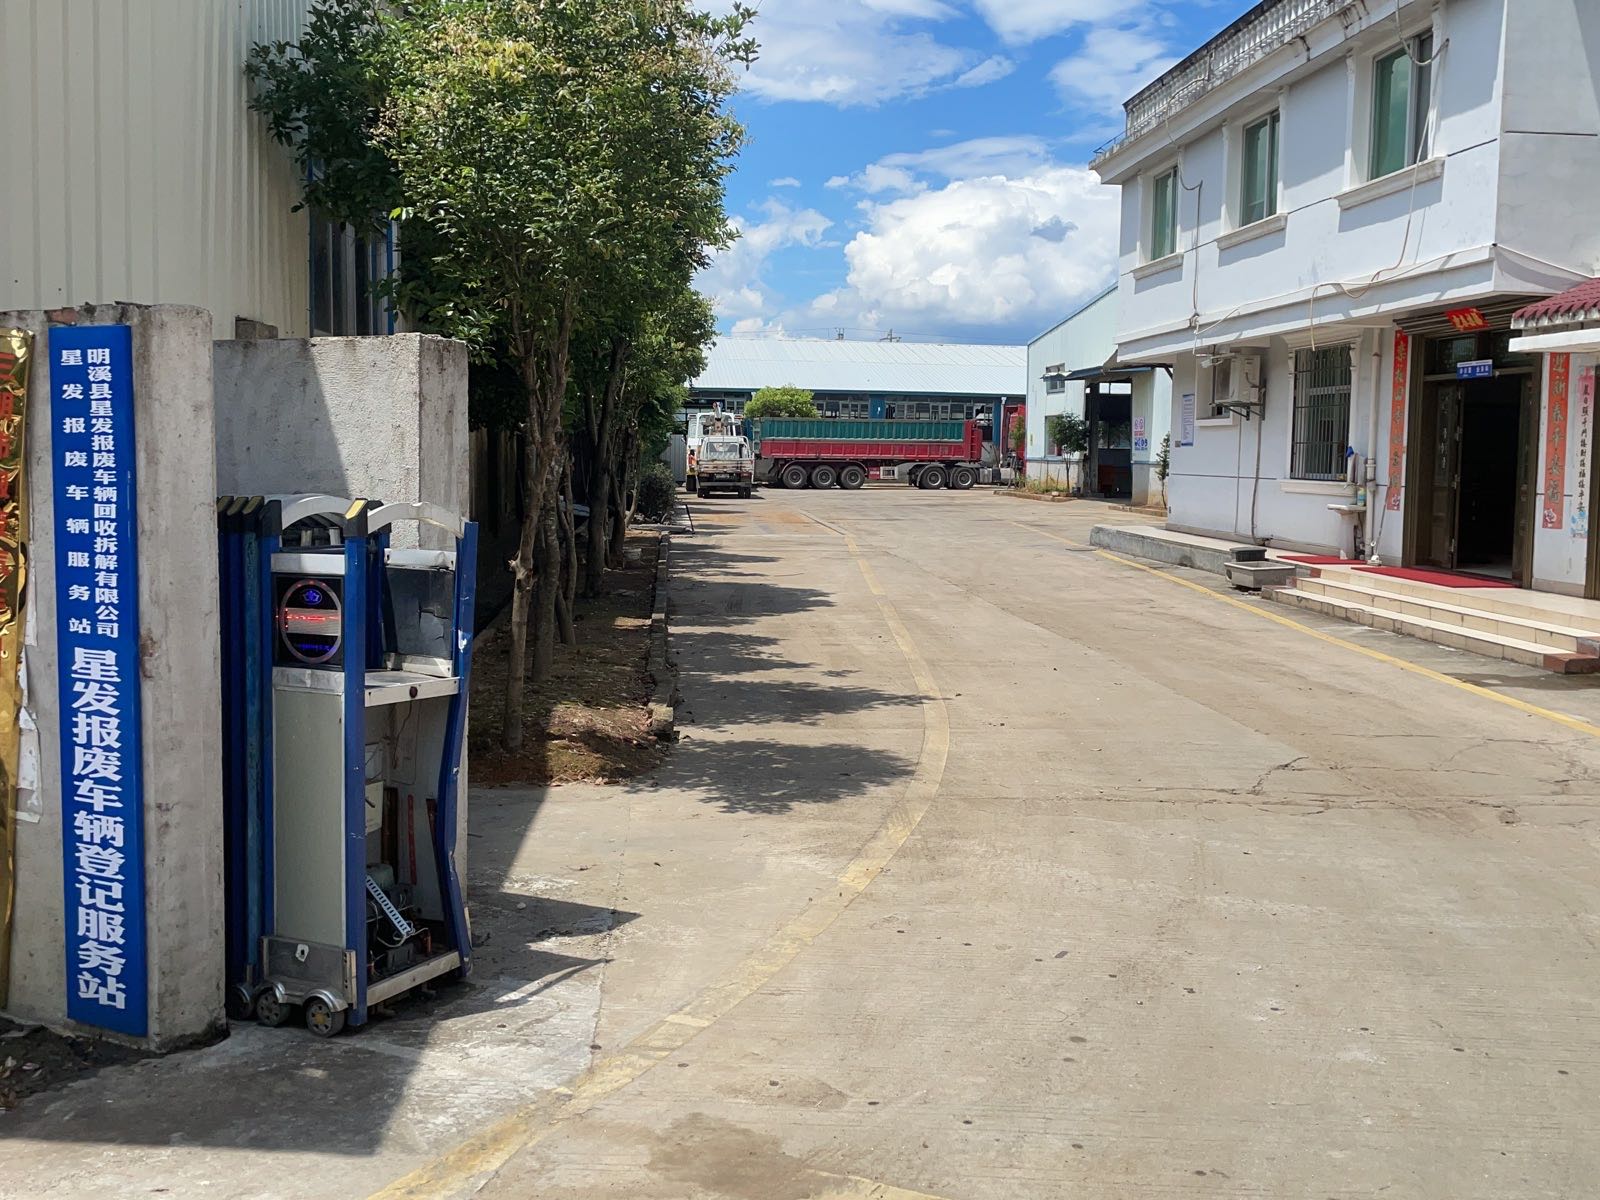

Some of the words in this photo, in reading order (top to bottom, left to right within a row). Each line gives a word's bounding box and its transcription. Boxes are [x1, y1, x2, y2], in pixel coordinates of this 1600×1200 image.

[60, 349, 91, 635] 星发报废车辆服务站
[87, 348, 119, 638] 明溪县星发报废车辆回收拆解有限公司
[71, 647, 126, 1010] 星发报废车辆登记服务站
